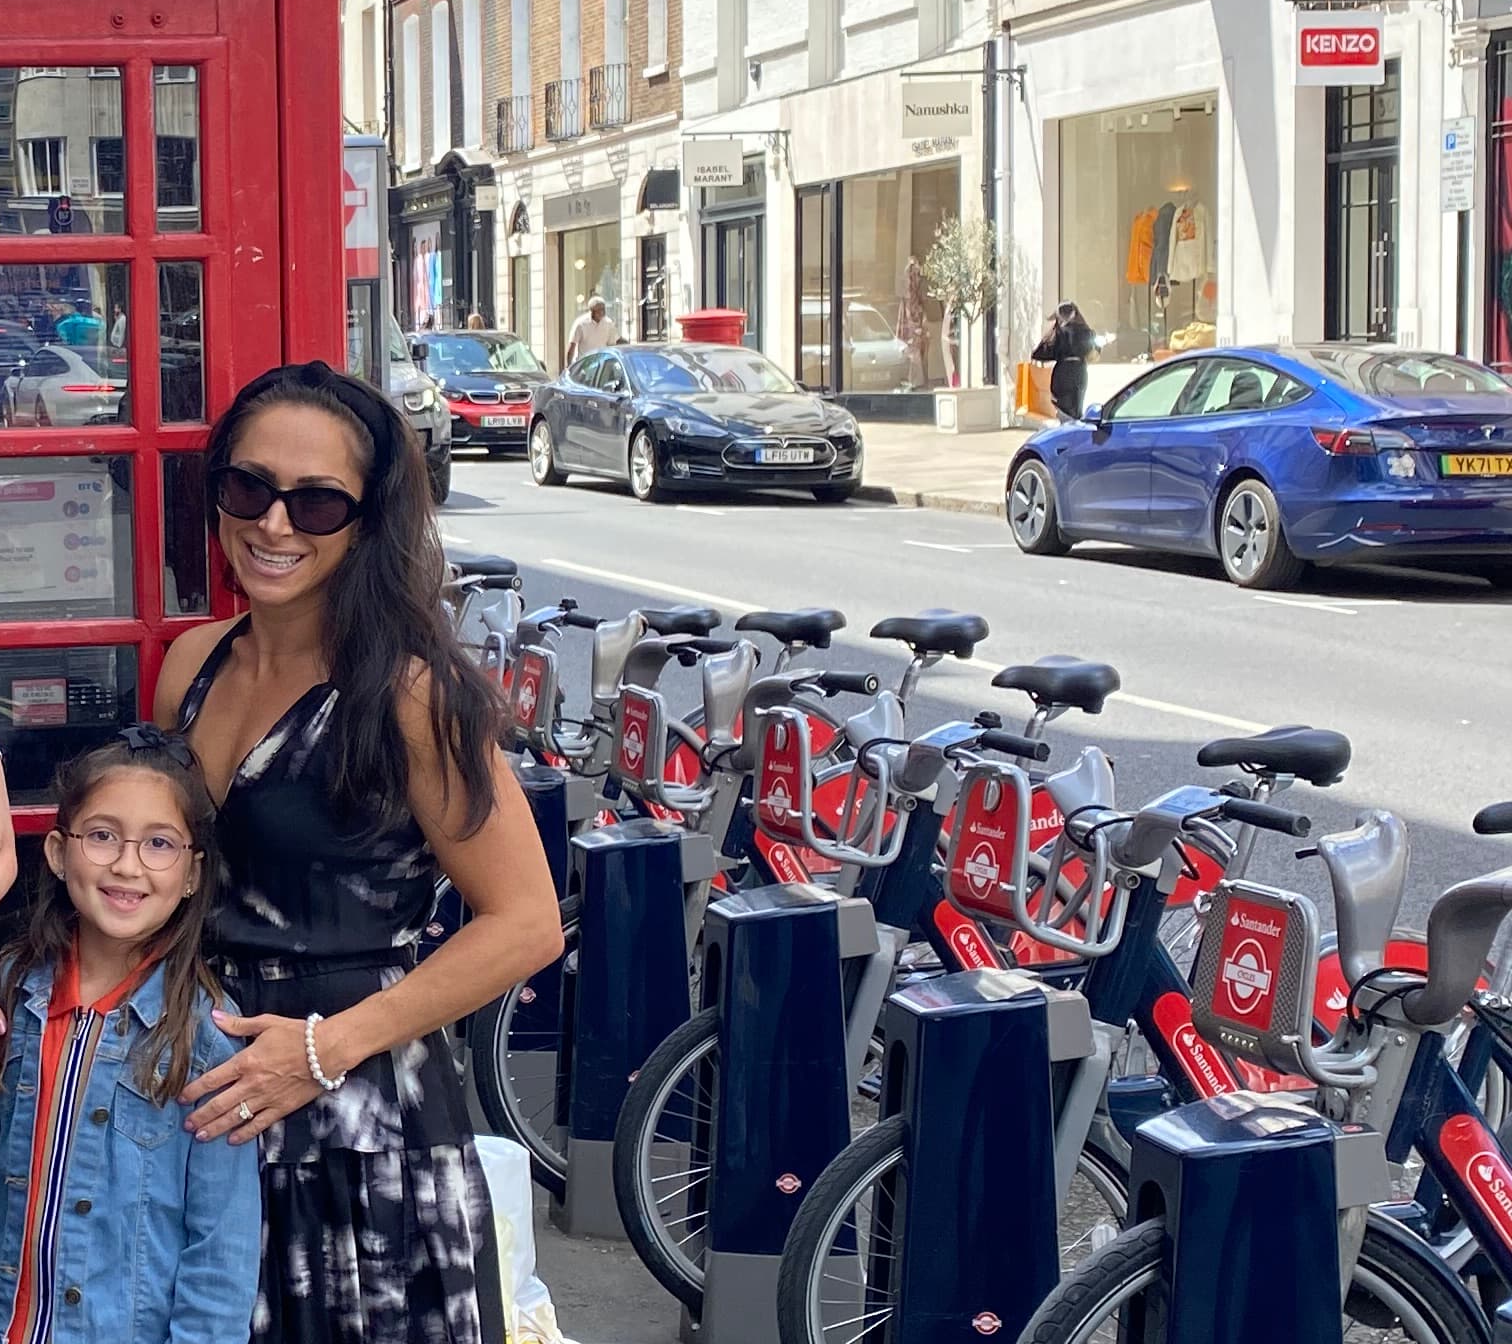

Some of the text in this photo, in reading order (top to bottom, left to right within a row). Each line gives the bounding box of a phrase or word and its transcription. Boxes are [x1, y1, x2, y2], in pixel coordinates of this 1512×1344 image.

[1305, 33, 1376, 53] KENZO
[904, 102, 969, 117] Nanushka
[694, 174, 733, 183] MARANT
[696, 165, 730, 174] ISABEL
[1455, 457, 1512, 472] YK71 TX
[1029, 808, 1066, 832] ande
[975, 821, 1007, 840] Santander
[1239, 912, 1281, 938] Santander
[965, 942, 985, 968] Sant
[1189, 1043, 1227, 1096] Santand
[1488, 1178, 1512, 1220] Sant
